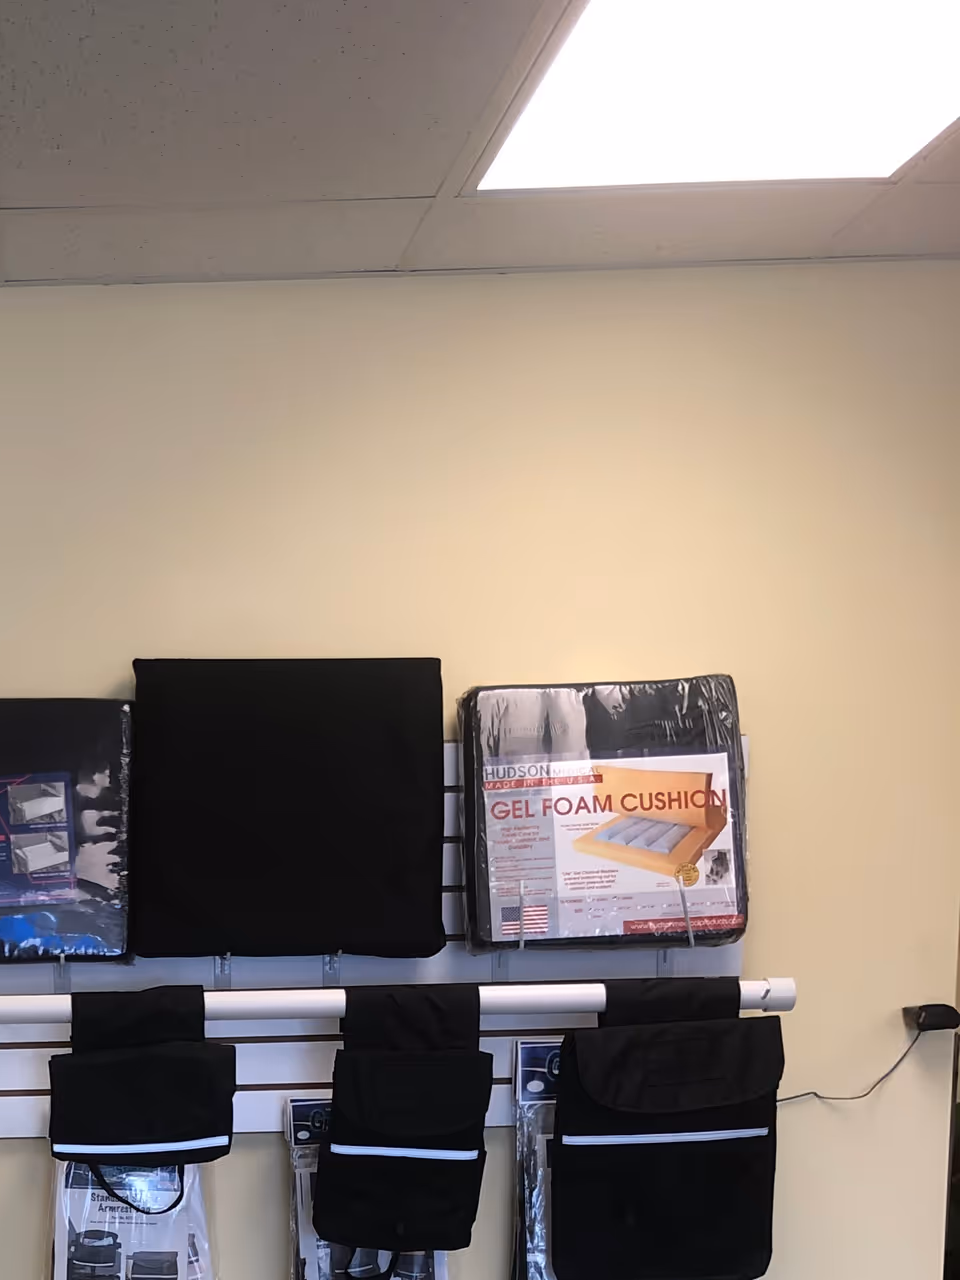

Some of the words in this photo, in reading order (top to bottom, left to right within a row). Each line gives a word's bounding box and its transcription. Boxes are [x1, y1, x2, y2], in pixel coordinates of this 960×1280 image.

[484, 765, 550, 781] HUDSON
[485, 780, 517, 789] MADE
[490, 801, 536, 821] GEL
[542, 794, 614, 817] FOAM
[620, 788, 727, 813] CUSHION
[90, 1192, 129, 1202] Standd
[98, 1203, 132, 1214] Armrest
